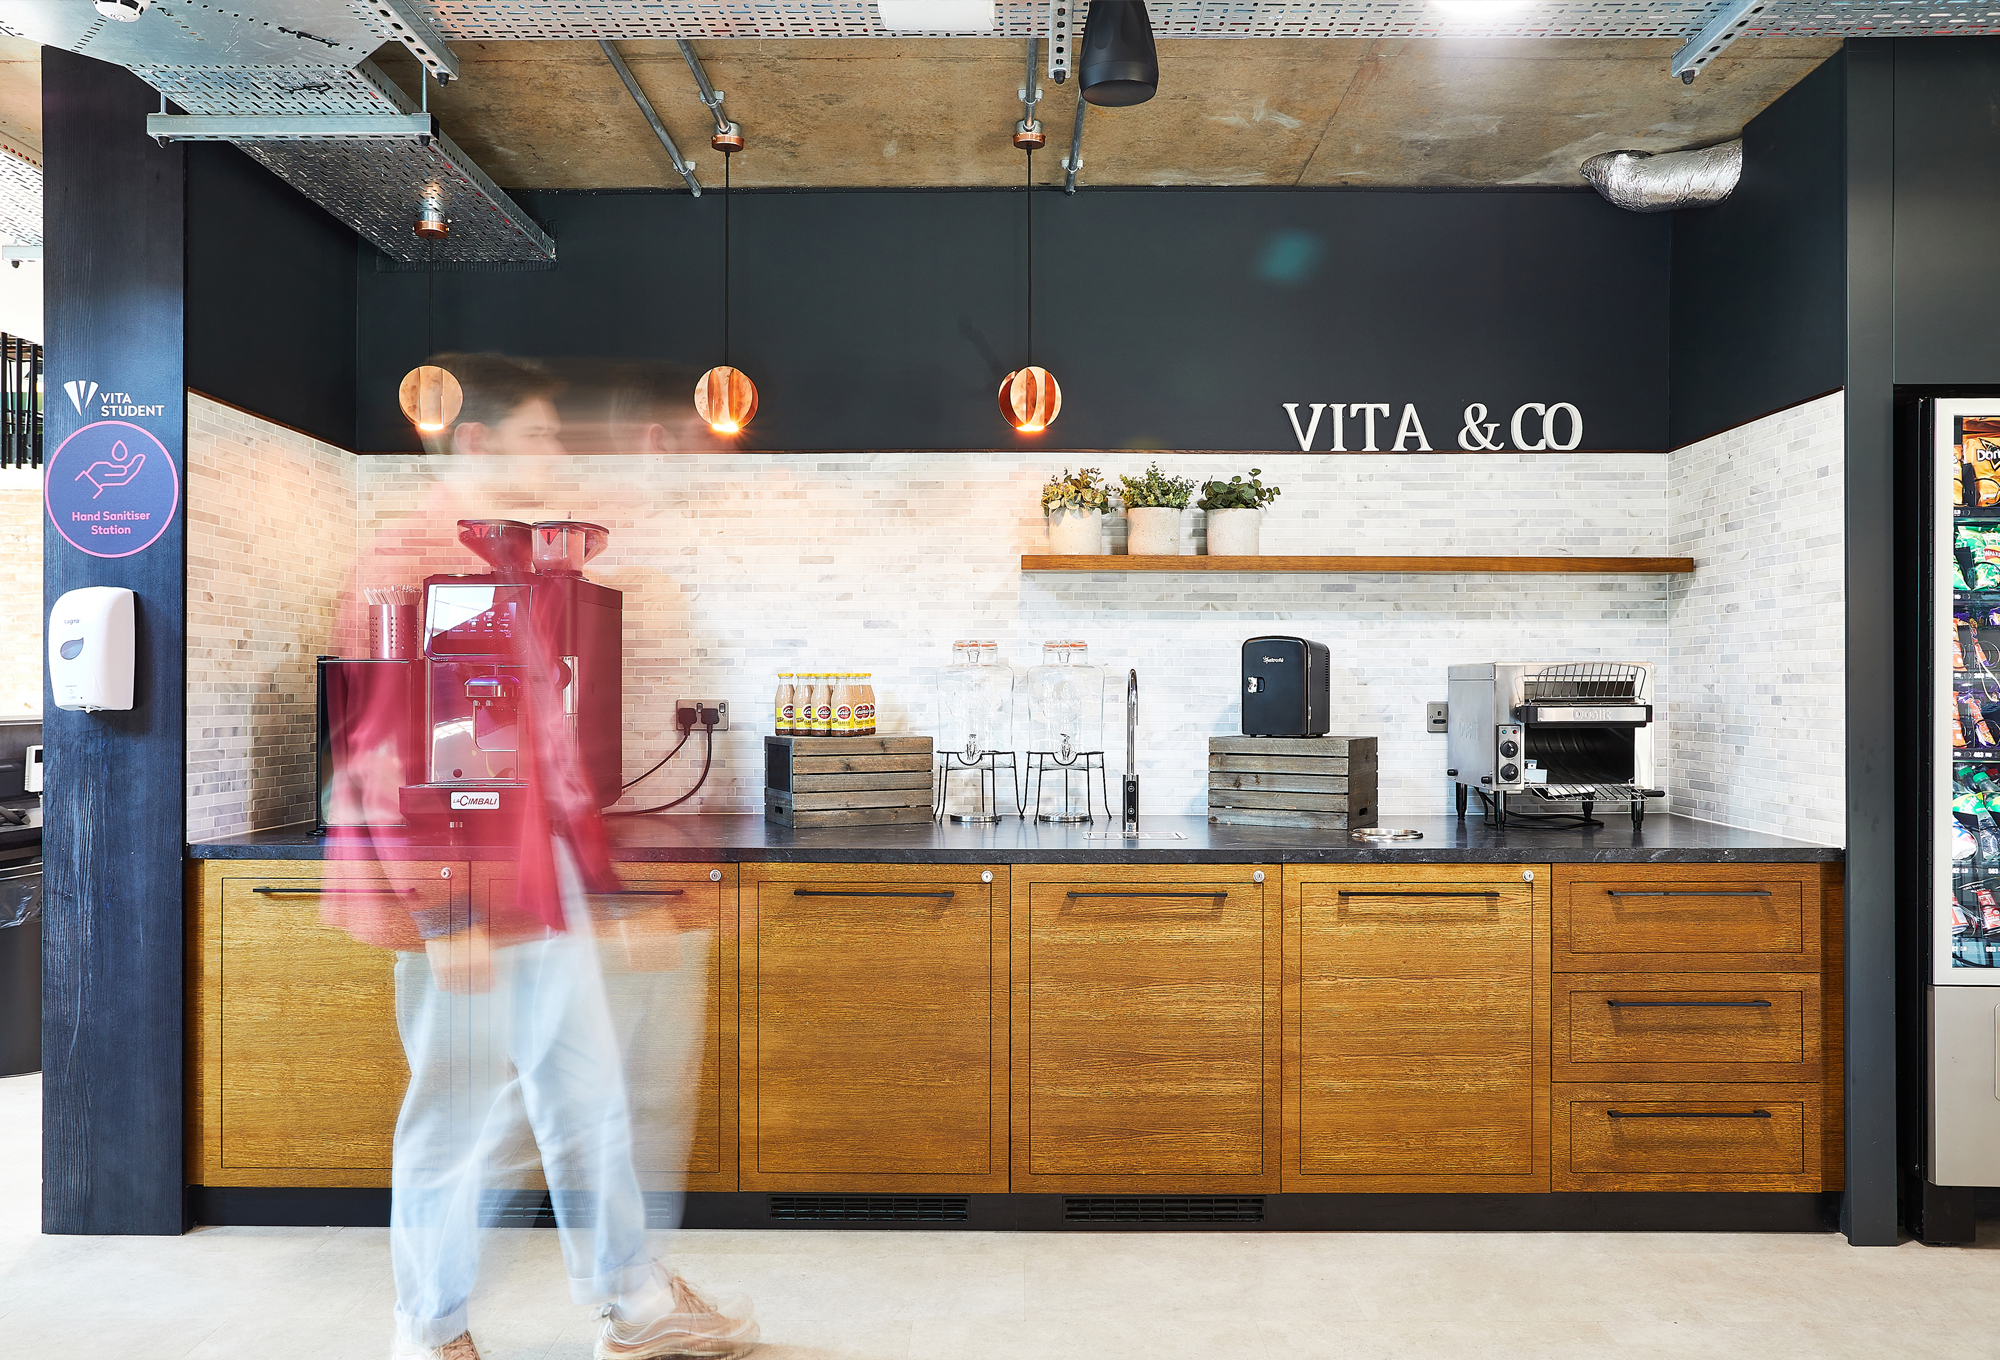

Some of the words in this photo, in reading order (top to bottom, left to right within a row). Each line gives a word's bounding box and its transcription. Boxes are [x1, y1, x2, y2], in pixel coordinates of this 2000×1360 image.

[100, 392, 132, 404] VITA
[101, 405, 165, 417] STUDENT
[1282, 402, 1433, 452] VITA
[72, 511, 101, 521] Hand
[102, 510, 151, 520] Sanitiser
[91, 524, 131, 535] Station
[460, 795, 498, 806] CIMBALI
